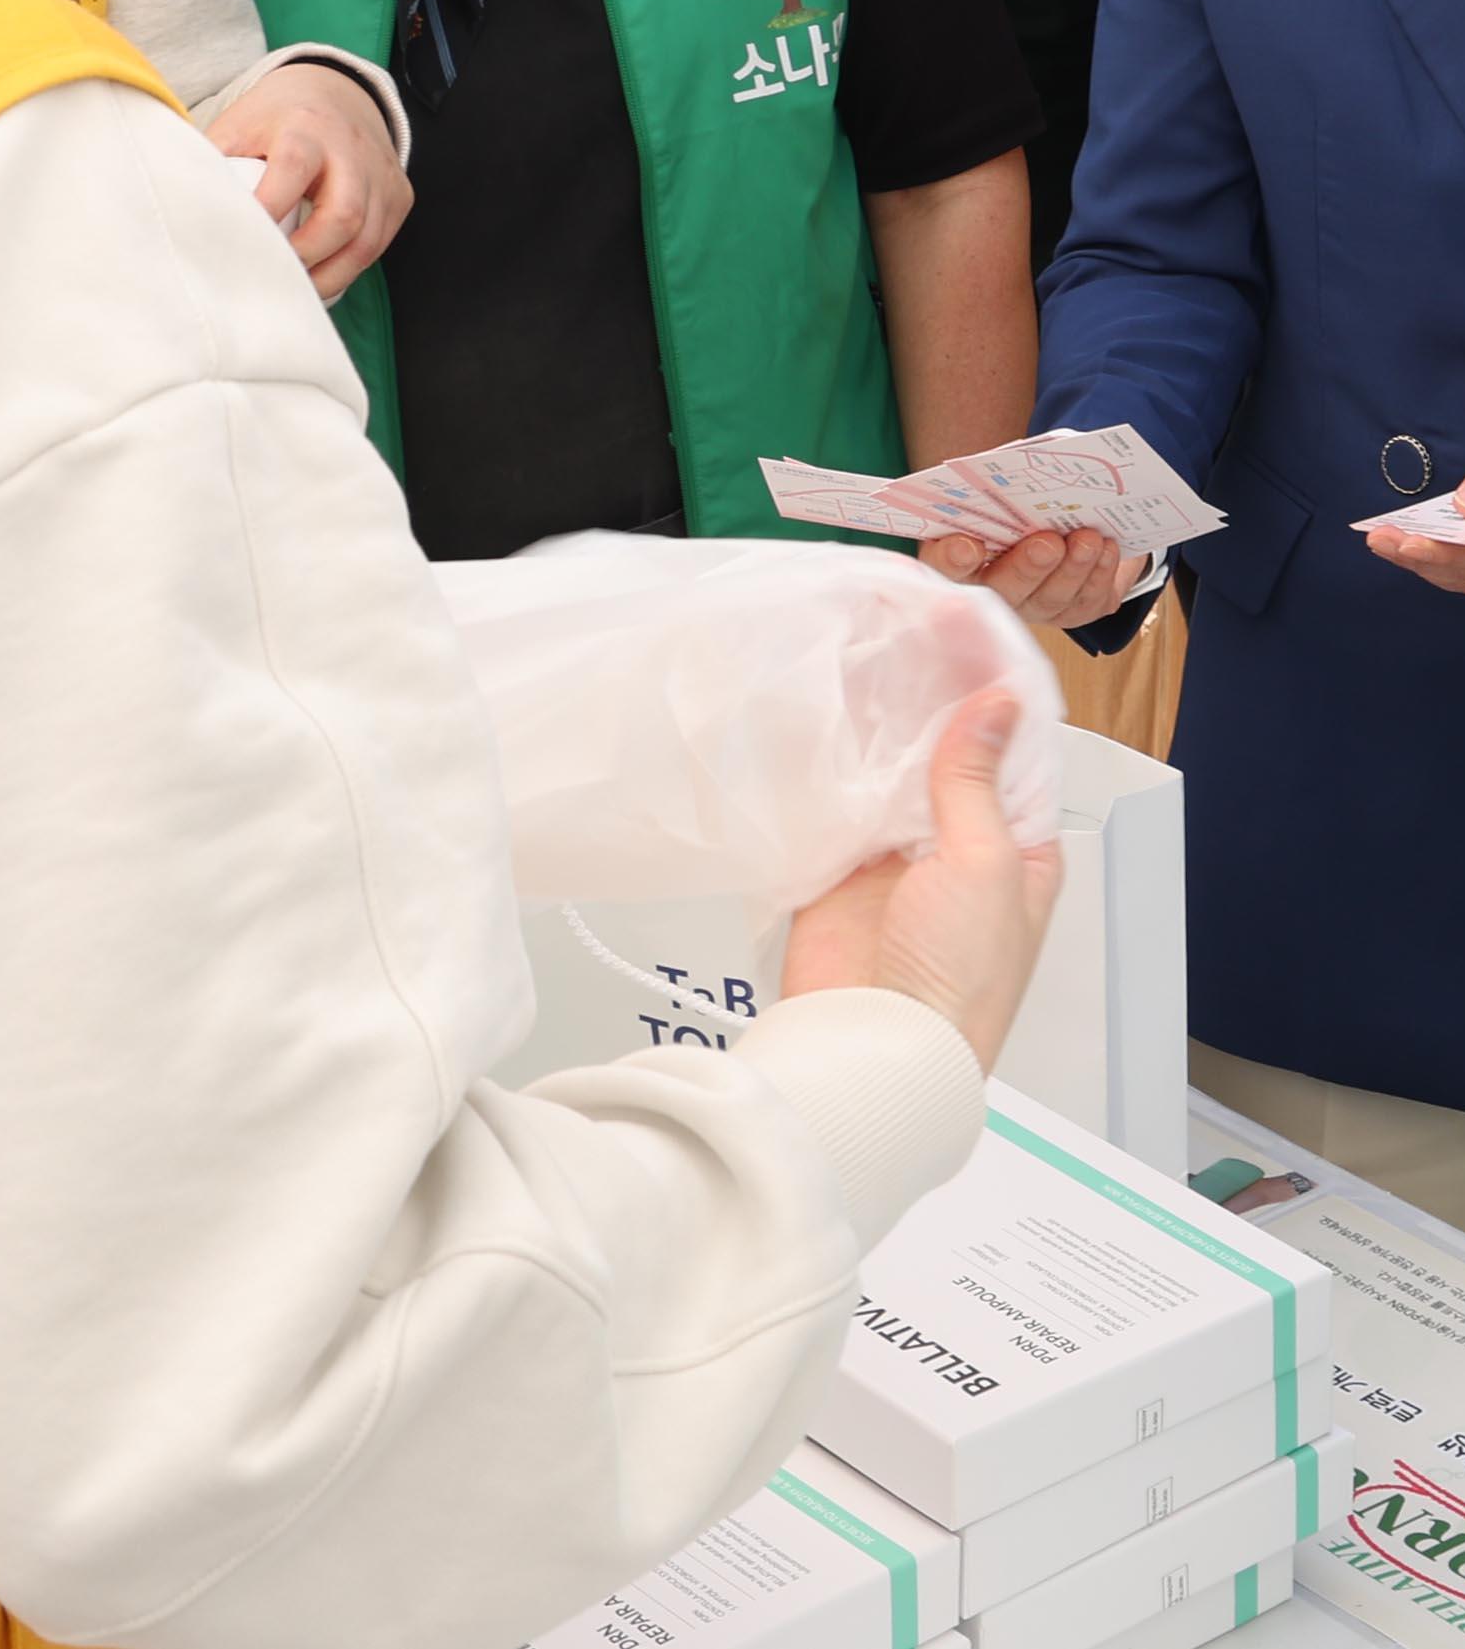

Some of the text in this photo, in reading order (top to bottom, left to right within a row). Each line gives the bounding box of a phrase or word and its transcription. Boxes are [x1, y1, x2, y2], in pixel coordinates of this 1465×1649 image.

[949, 1274, 1082, 1354] REPAIR AMPOULE
[1007, 1333, 1060, 1364] PDRN
[1359, 1383, 1423, 1426] 탄력
[594, 1622, 642, 1649] DRN
[611, 1603, 677, 1645] REPAIR
